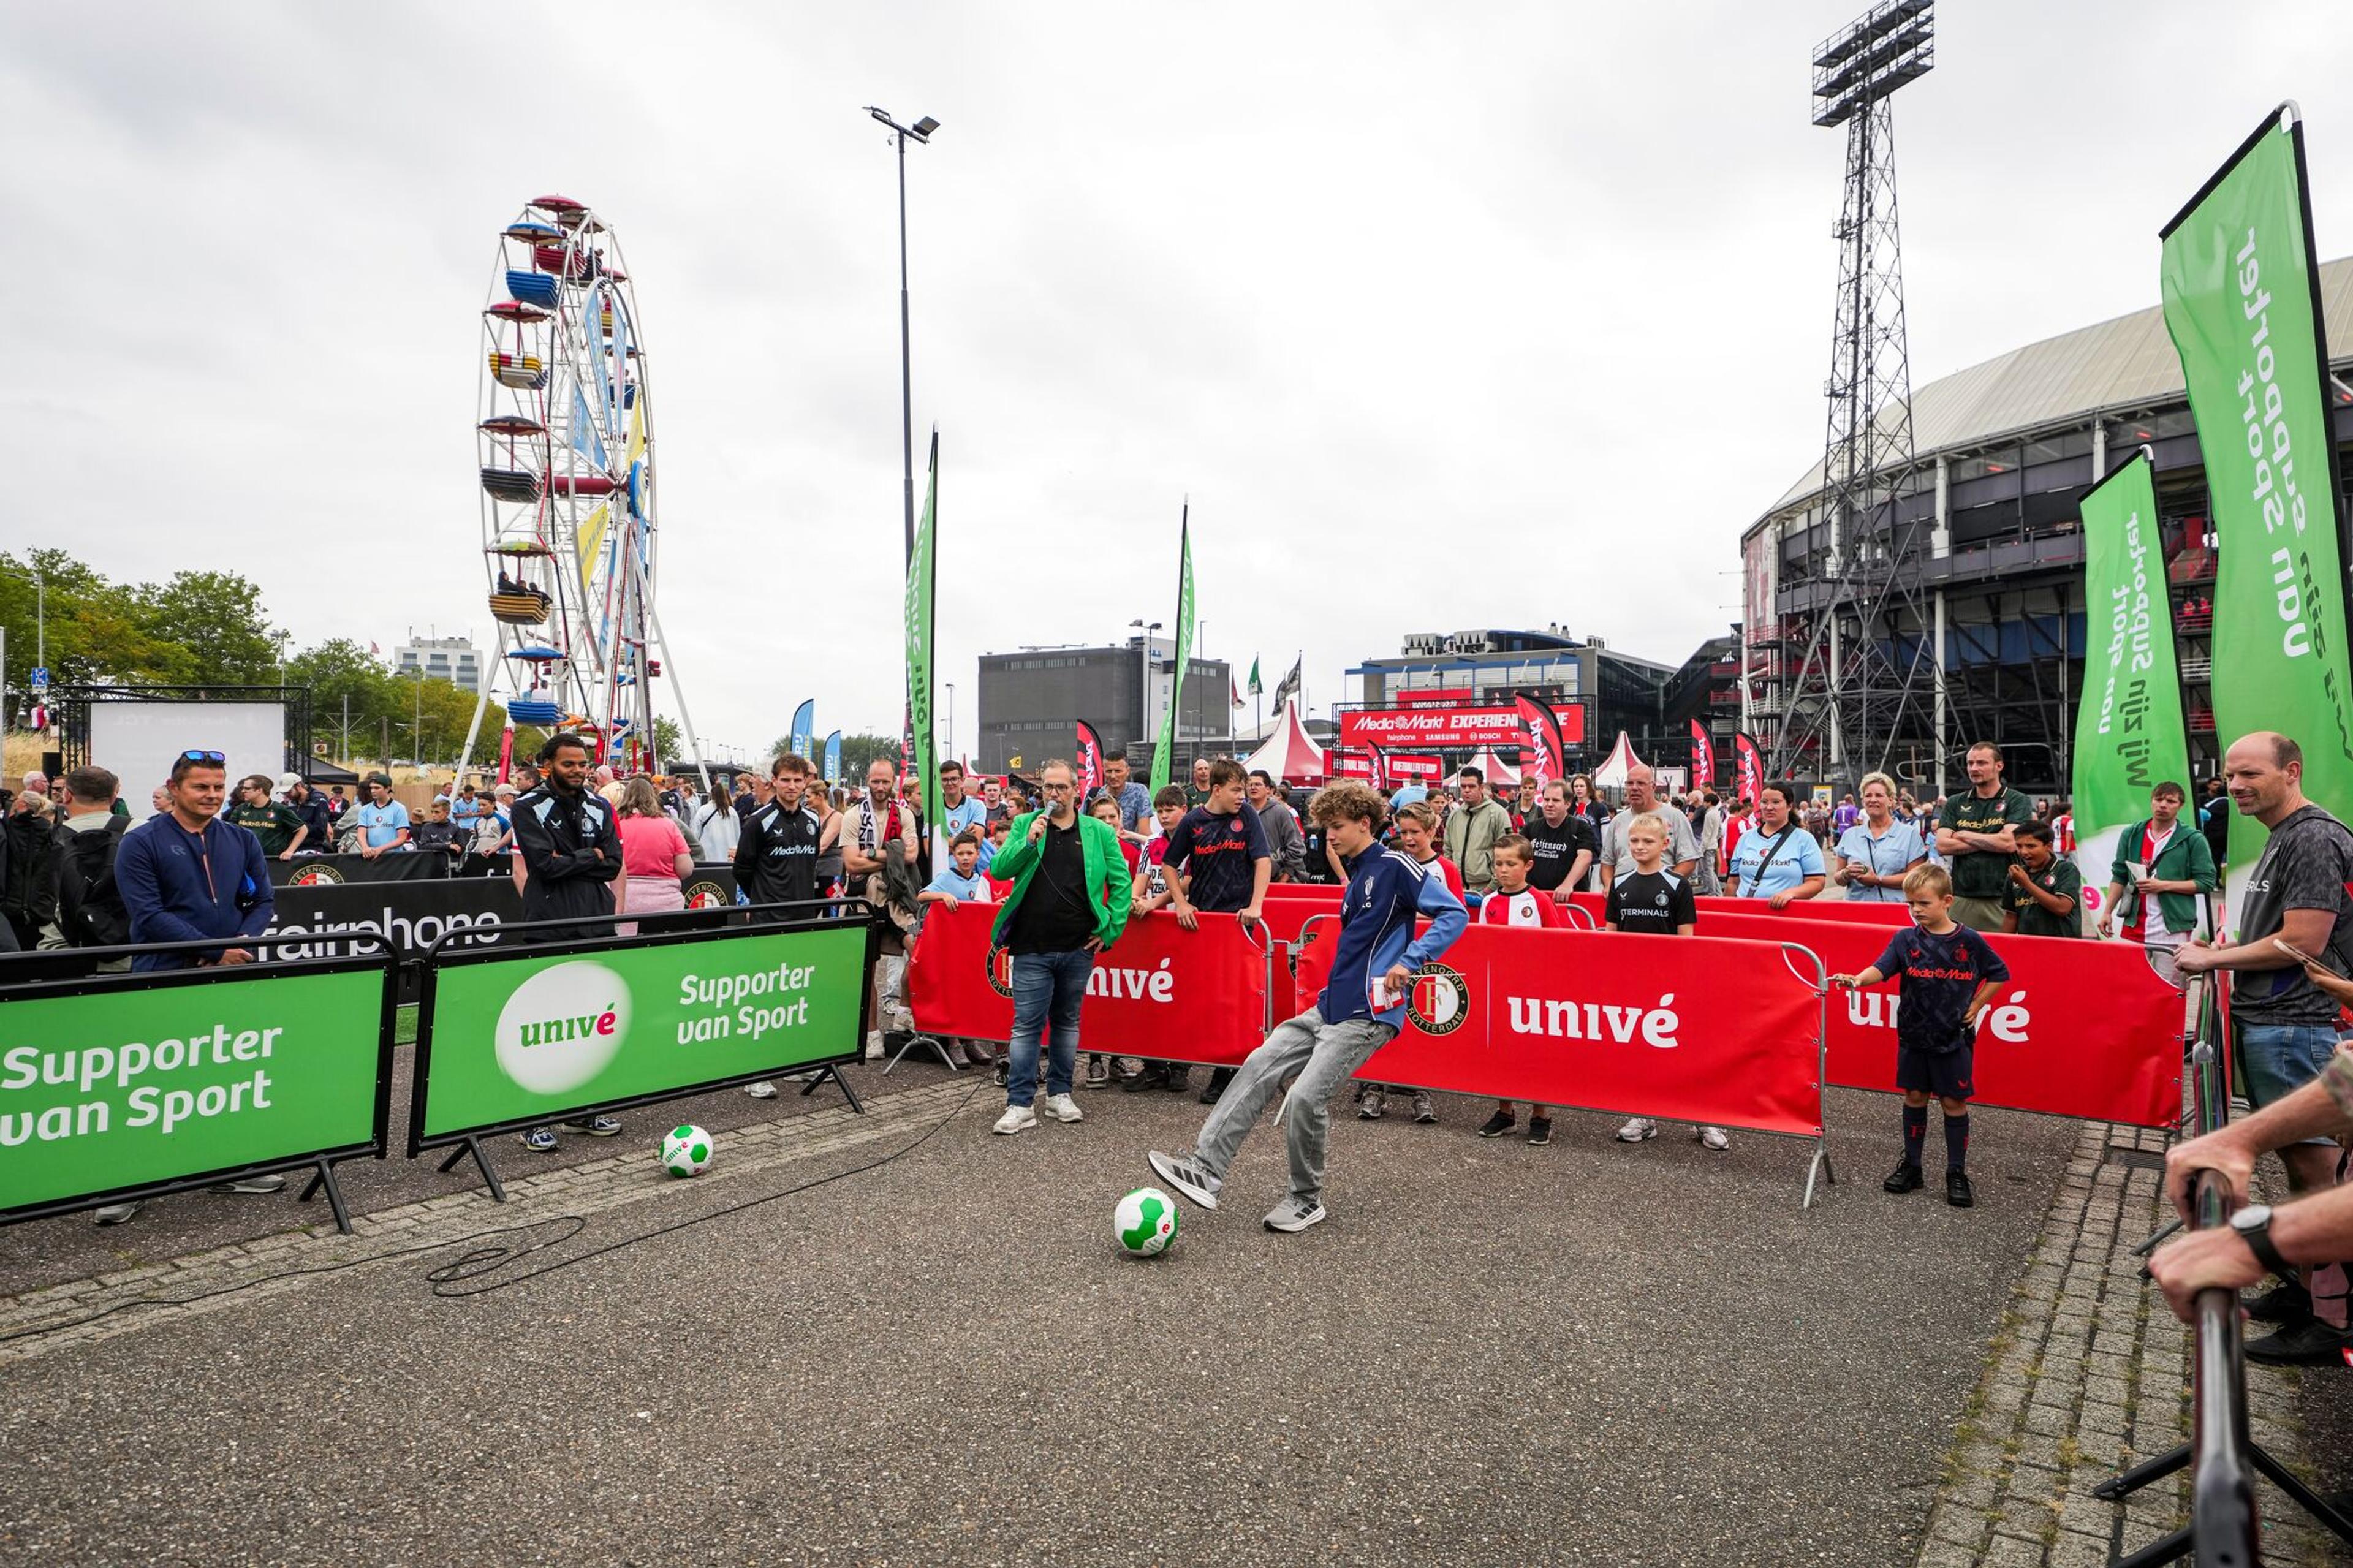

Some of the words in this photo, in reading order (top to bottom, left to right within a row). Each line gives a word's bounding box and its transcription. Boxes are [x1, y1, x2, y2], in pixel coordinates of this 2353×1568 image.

[1353, 717, 1394, 730] Media
[1405, 714, 1444, 729] Markt
[1450, 714, 1518, 728] EXPERIEN
[292, 866, 341, 884] FEYENOORD
[684, 884, 726, 906] FEYENOORD
[262, 907, 501, 961] fairphone
[680, 963, 816, 1010] Supporter
[988, 975, 1014, 997] ROTTE
[1086, 957, 1173, 1002] nivé
[1409, 964, 1464, 991] FEYENOORD
[520, 1002, 616, 1047] univé
[677, 1013, 730, 1045] van
[737, 996, 809, 1040] Sport
[1407, 1006, 1464, 1033] ROTTERDAM
[1507, 993, 1679, 1048] univé
[1, 1024, 283, 1093] Supporter
[0, 1100, 110, 1146] van
[126, 1070, 272, 1134] Sport
